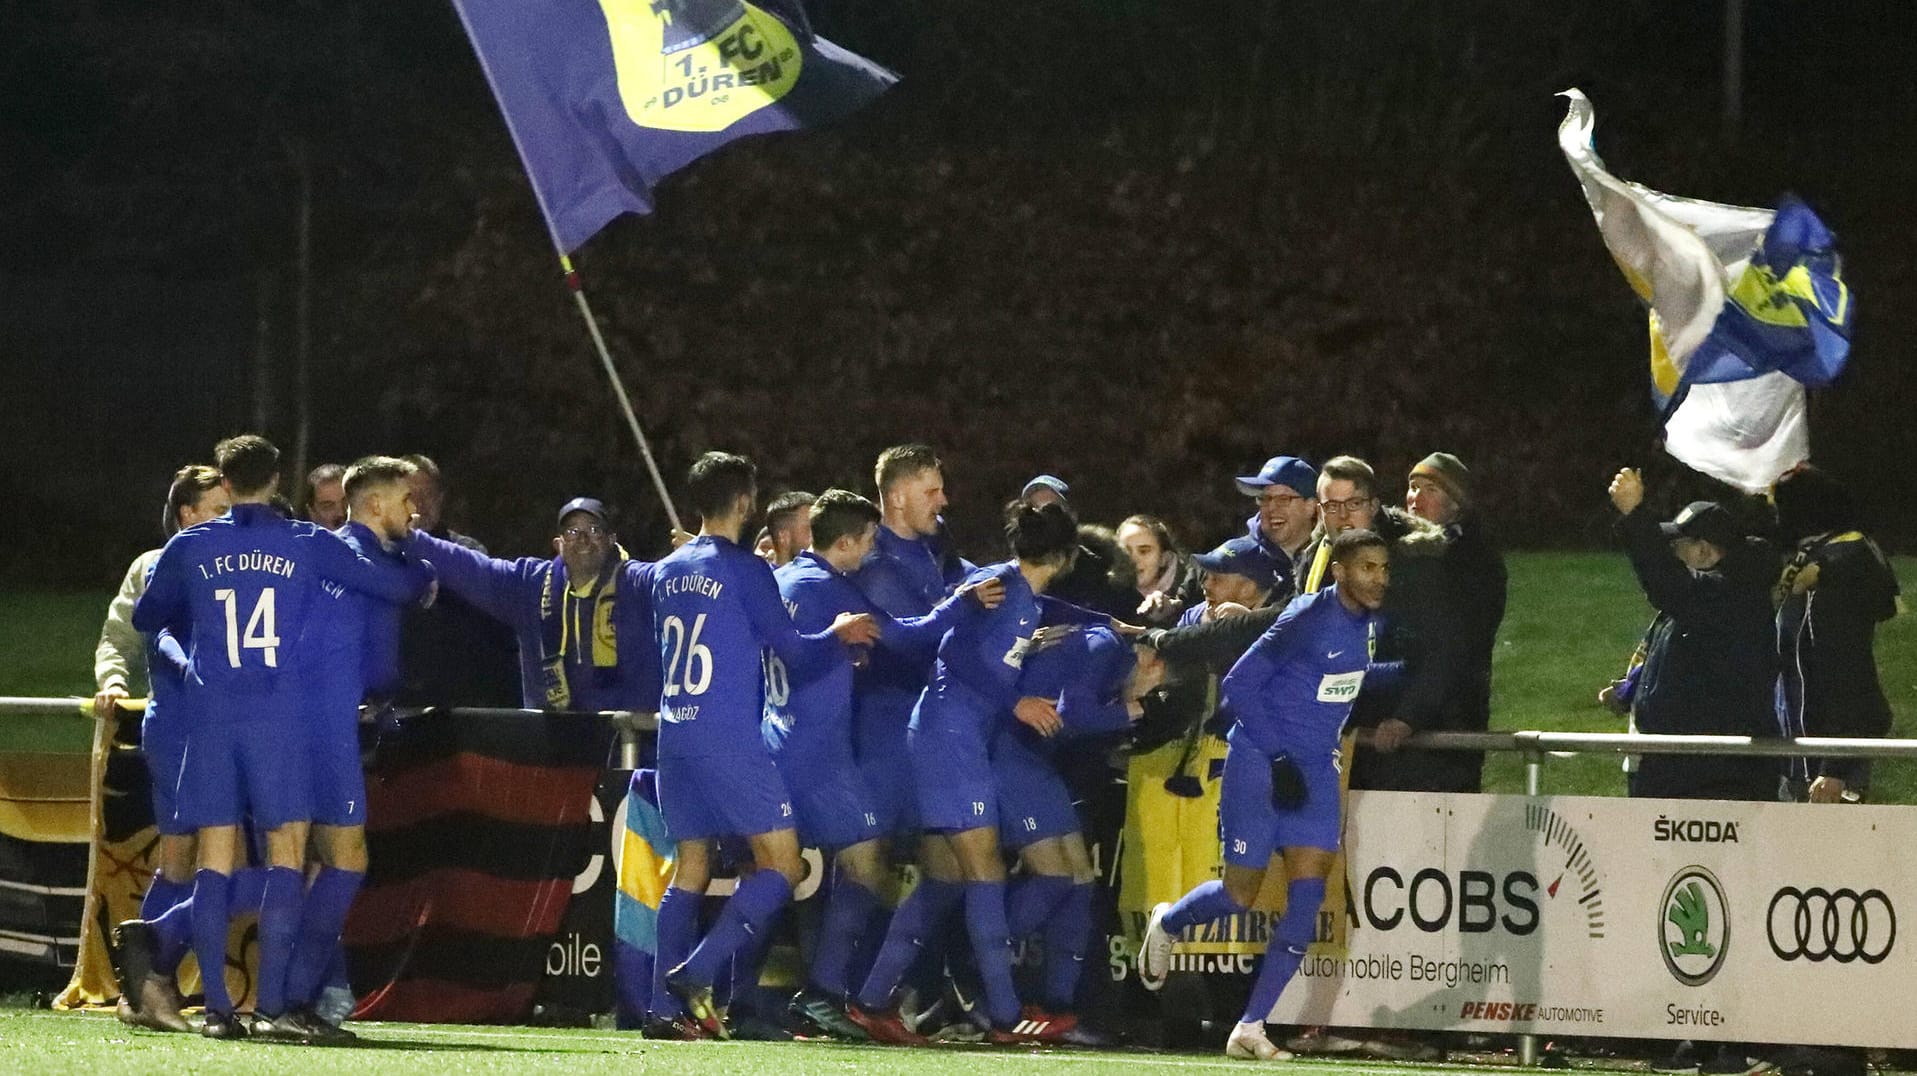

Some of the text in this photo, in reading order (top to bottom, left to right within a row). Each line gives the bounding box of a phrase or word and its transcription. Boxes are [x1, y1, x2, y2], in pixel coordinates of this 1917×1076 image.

[674, 23, 764, 78] 1. FC
[663, 57, 783, 109] DÜREN
[198, 549, 296, 580] 1. FC DÜREN
[665, 576, 679, 598] FC
[680, 570, 724, 601] DÜREN
[214, 587, 281, 669] 14
[662, 613, 714, 698] 26
[347, 800, 355, 815] 7
[780, 801, 793, 817] 26
[863, 812, 877, 828] 16
[972, 801, 985, 816] 19
[1022, 816, 1037, 832] 18
[1654, 814, 1740, 843] ŠKODA
[1233, 838, 1247, 855] 30
[1344, 866, 1541, 936] COBS
[1410, 954, 1509, 988] Bergheim
[1460, 1001, 1604, 1023] PENSKE AUTOMOTIVE
